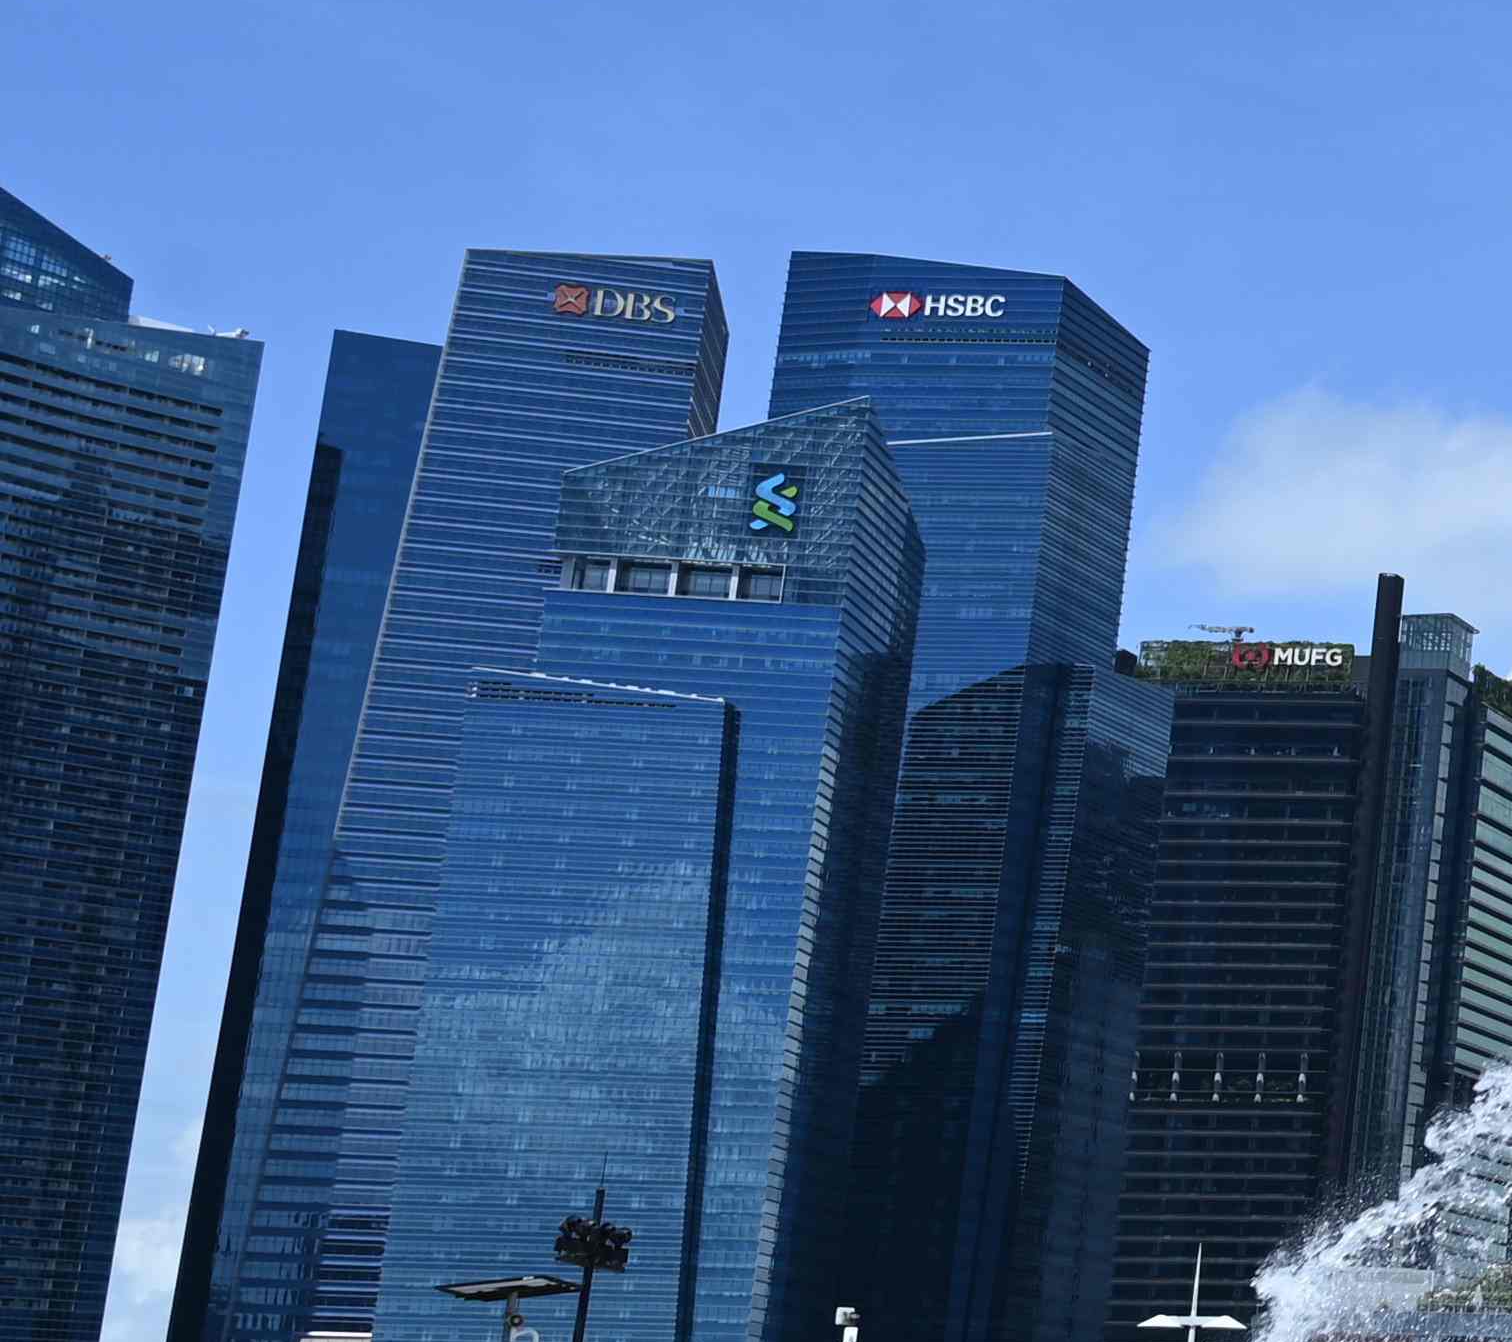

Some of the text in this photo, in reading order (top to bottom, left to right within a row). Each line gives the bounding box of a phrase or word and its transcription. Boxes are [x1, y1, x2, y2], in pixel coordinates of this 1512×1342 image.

[593, 288, 676, 324] DBS
[924, 294, 1006, 317] HSBC
[1273, 647, 1343, 667] MUFG
